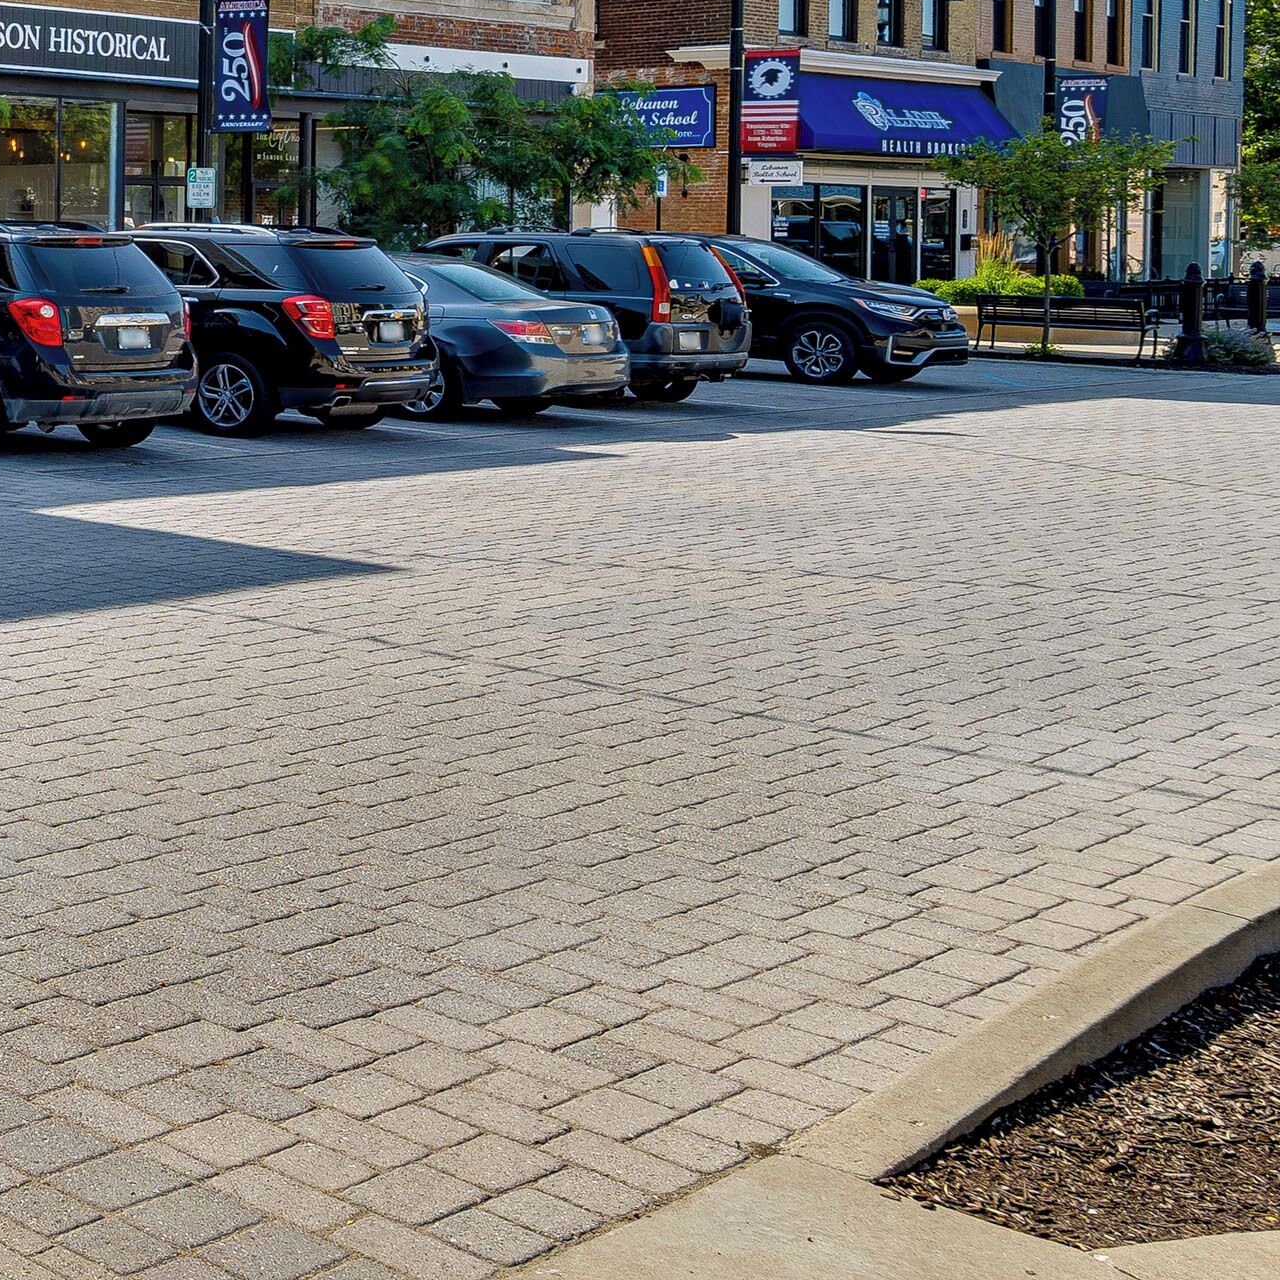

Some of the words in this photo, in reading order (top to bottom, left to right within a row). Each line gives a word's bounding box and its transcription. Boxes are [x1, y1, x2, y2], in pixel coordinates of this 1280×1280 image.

[48, 26, 171, 62] HISTORICAL
[619, 97, 680, 110] Lebanon
[649, 111, 698, 126] School
[881, 140, 921, 153] HEALTH
[189, 171, 196, 182] 2
